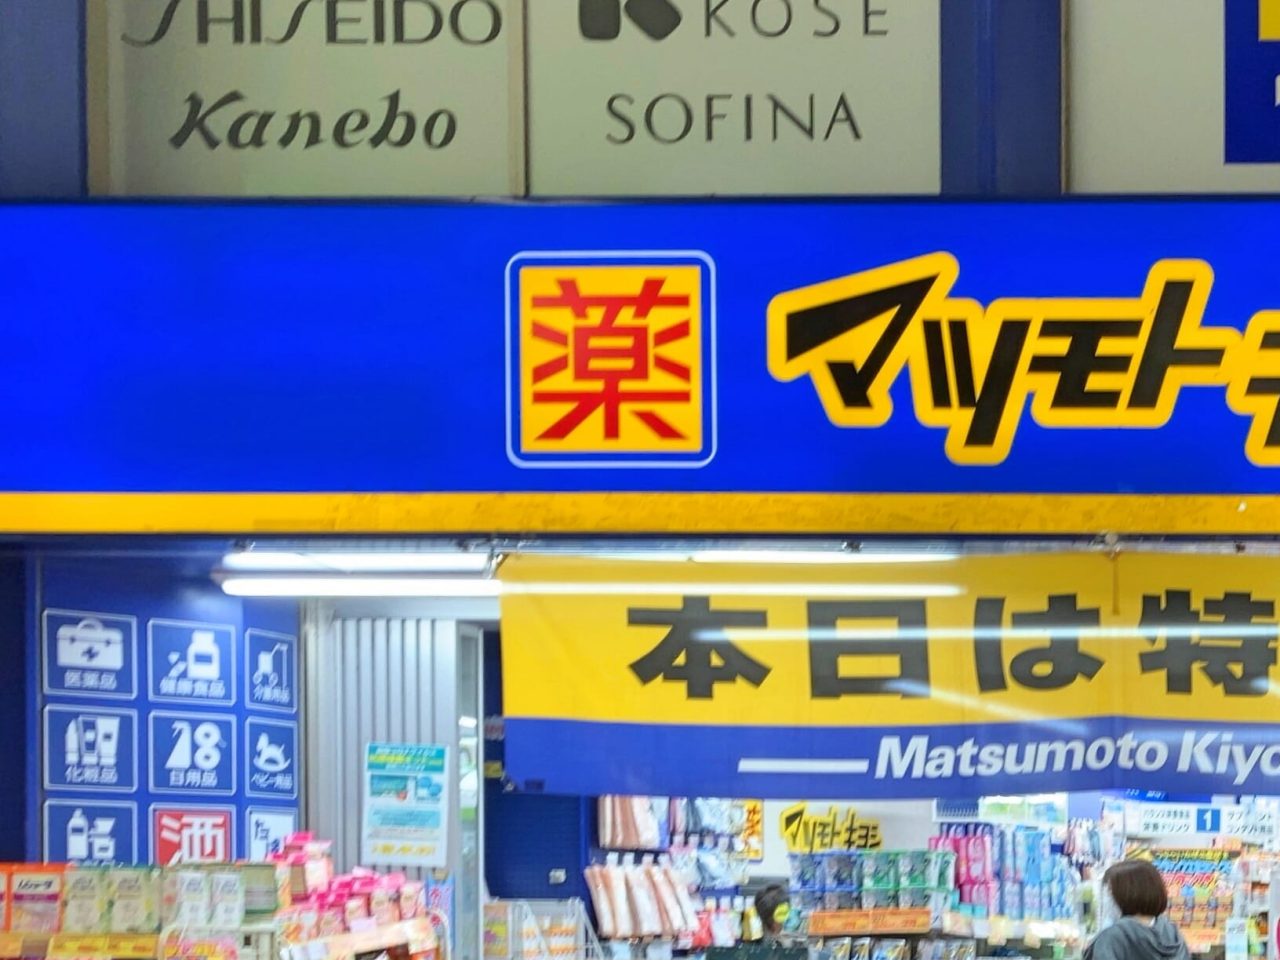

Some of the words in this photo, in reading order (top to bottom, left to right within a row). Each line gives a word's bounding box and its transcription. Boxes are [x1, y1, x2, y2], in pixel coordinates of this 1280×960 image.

[168, 90, 458, 151] Kanebo
[605, 92, 862, 145] SOFINA
[531, 277, 692, 441] 薬
[168, 767, 218, 788] 日用品
[873, 732, 1168, 780] Matsumoto
[159, 813, 226, 866] 酒
